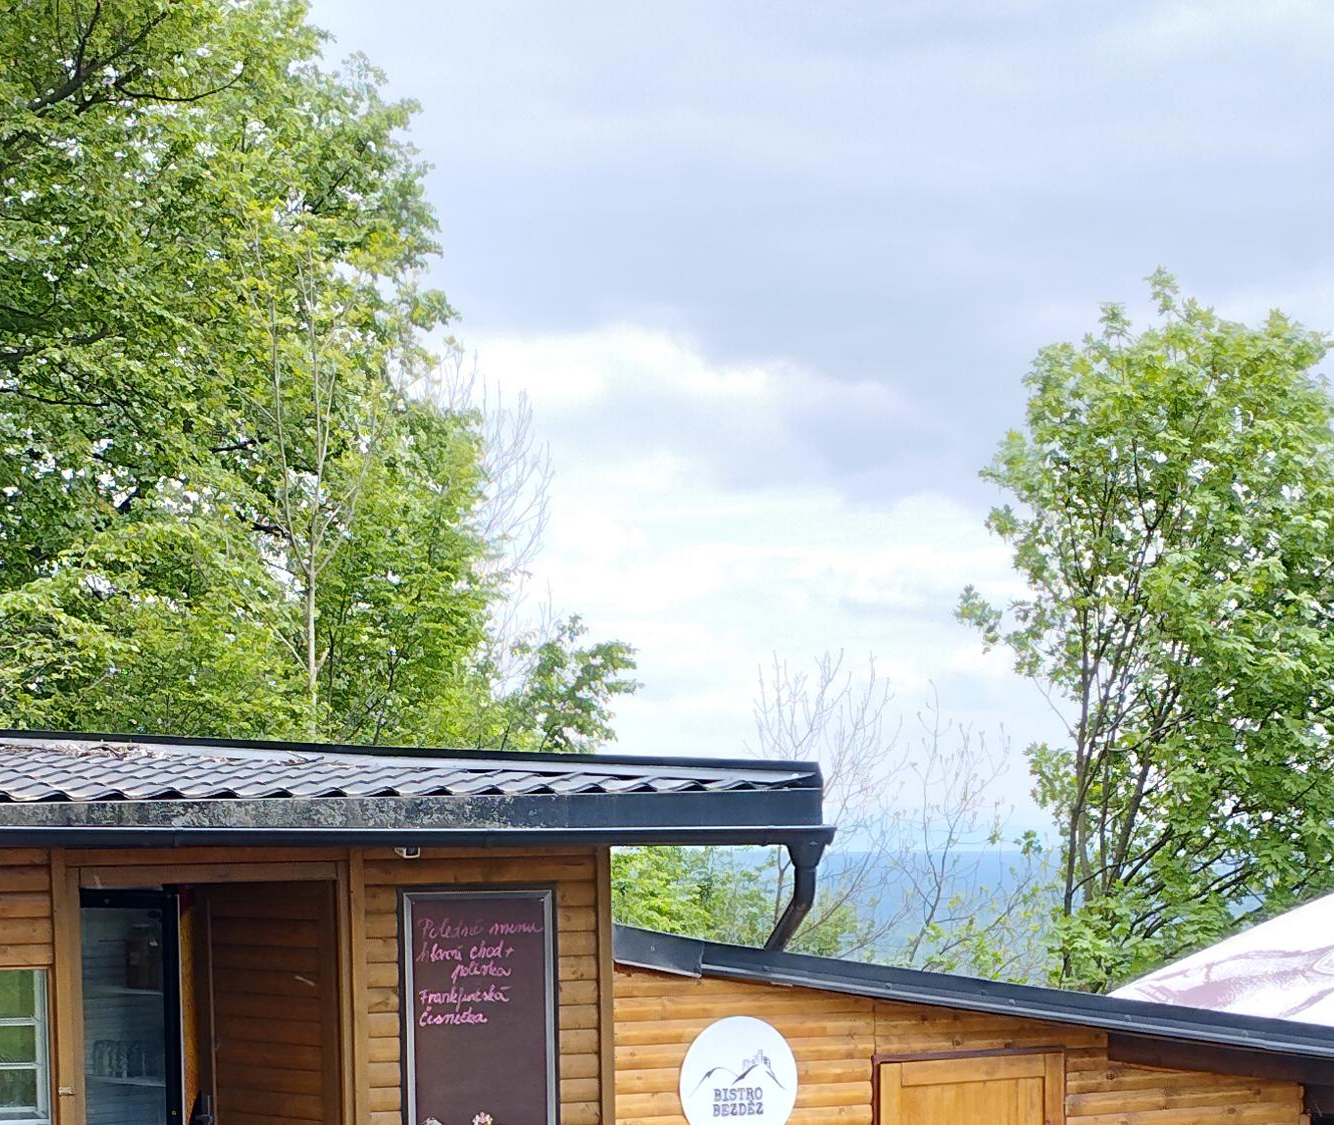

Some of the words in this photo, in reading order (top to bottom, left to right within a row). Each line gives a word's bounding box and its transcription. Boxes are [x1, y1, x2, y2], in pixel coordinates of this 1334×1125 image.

[489, 922, 544, 935] menu
[470, 940, 504, 959] chod
[713, 1087, 763, 1102] BISTRO
[713, 1100, 764, 1117] BEZDĚZ
